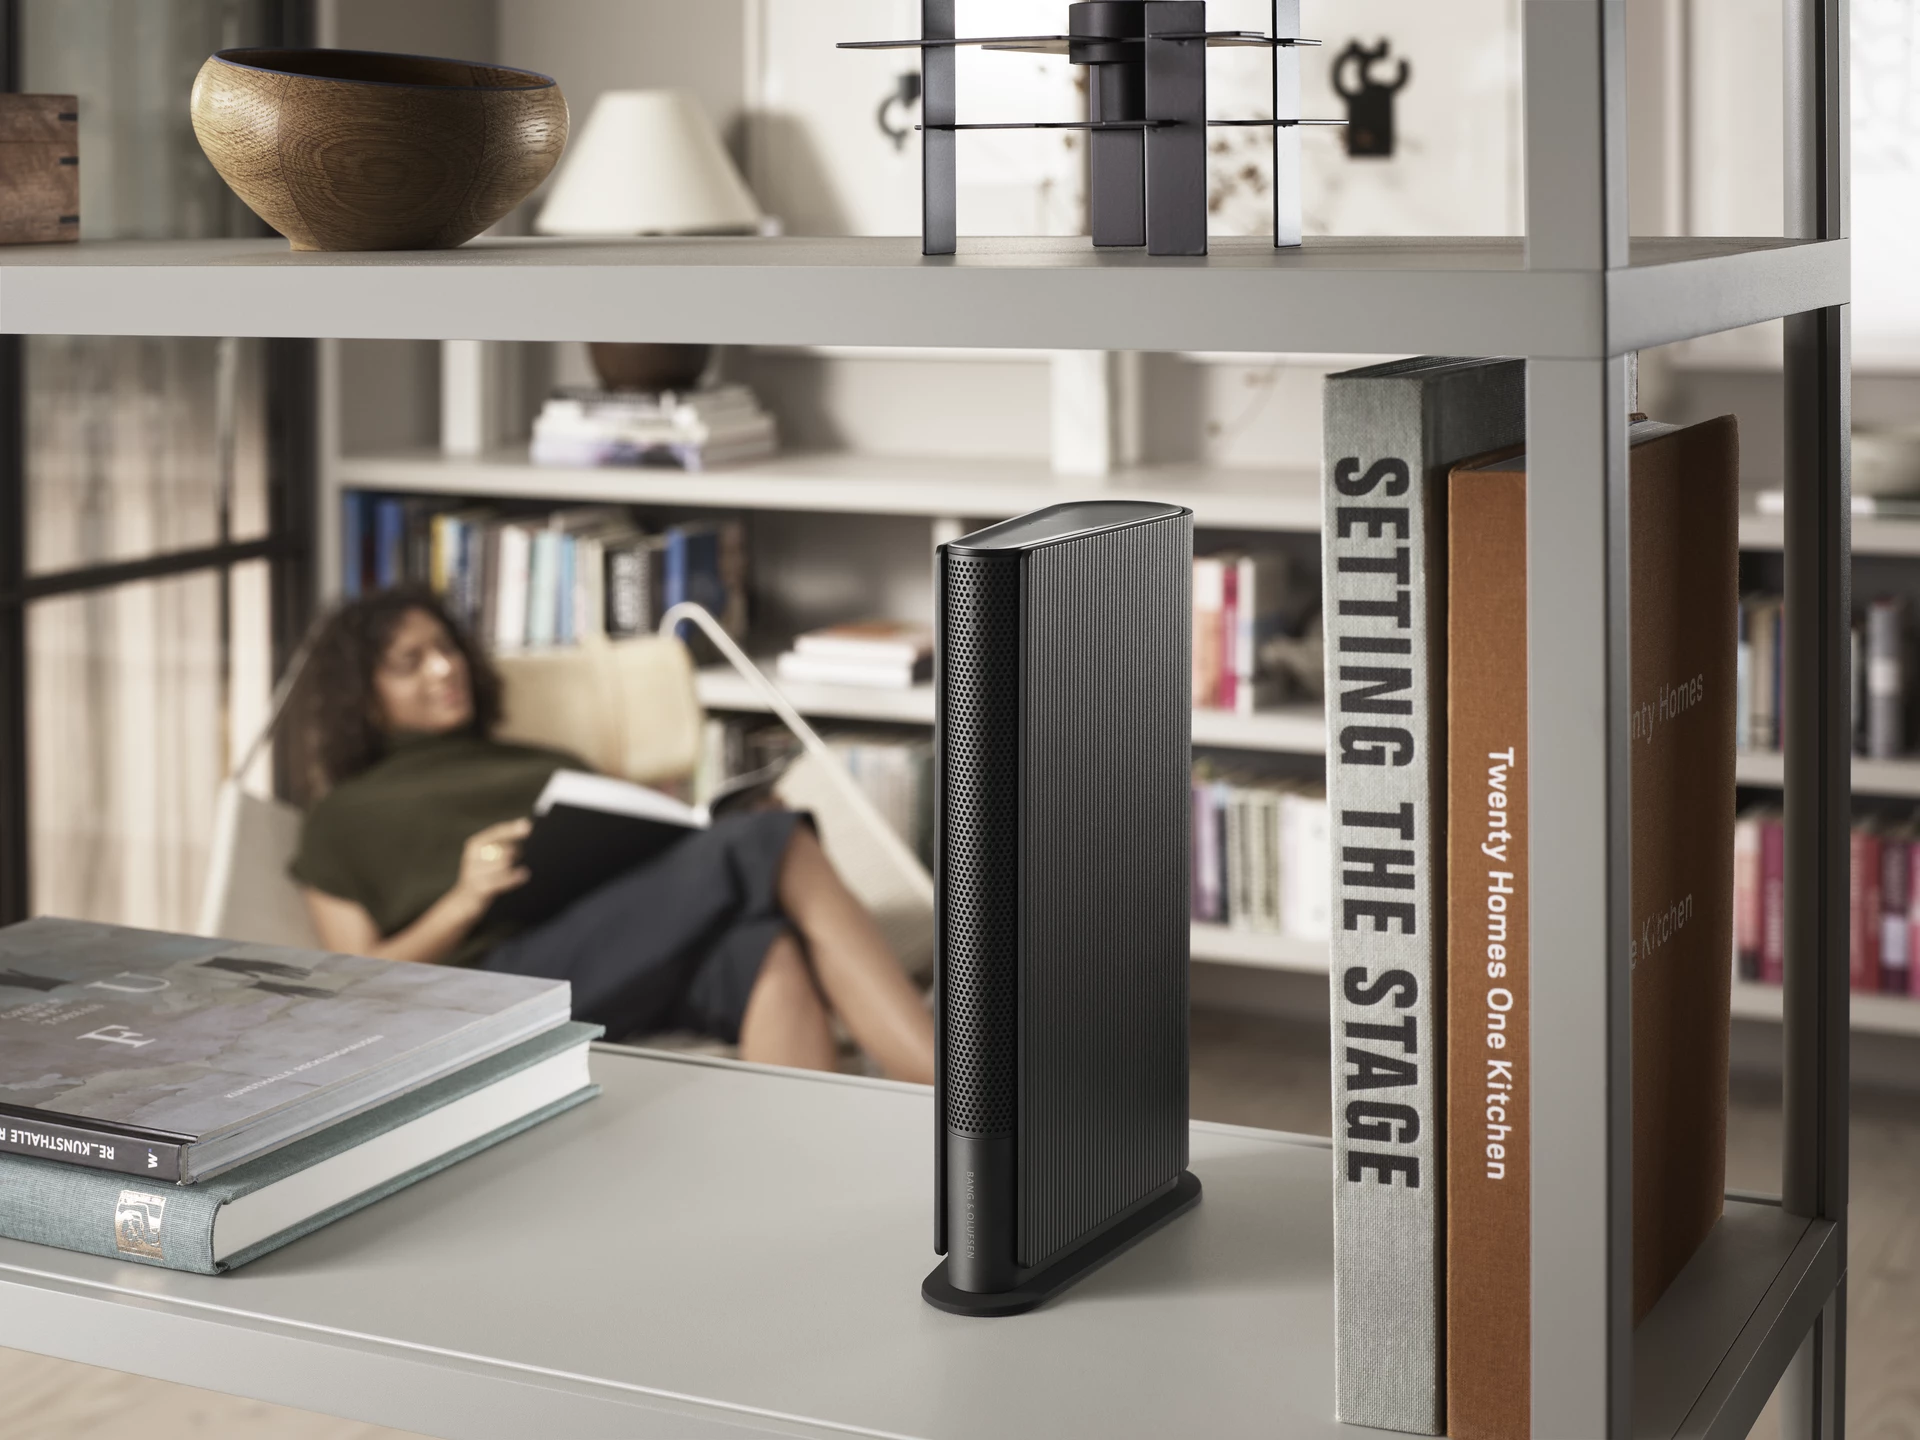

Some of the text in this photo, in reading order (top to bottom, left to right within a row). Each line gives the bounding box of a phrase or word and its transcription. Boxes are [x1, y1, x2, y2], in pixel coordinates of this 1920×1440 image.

[1632, 673, 1704, 744] nty Homes
[1334, 456, 1420, 1188] SETTING THE STAGE
[1641, 893, 1693, 960] Kitchen
[1481, 747, 1515, 1180] Twenty Homes One Kitchen
[10, 1129, 115, 1160] RE_KUNSTHALLE
[966, 1171, 975, 1200] BANG
[966, 1212, 975, 1259] OLUFSEN
